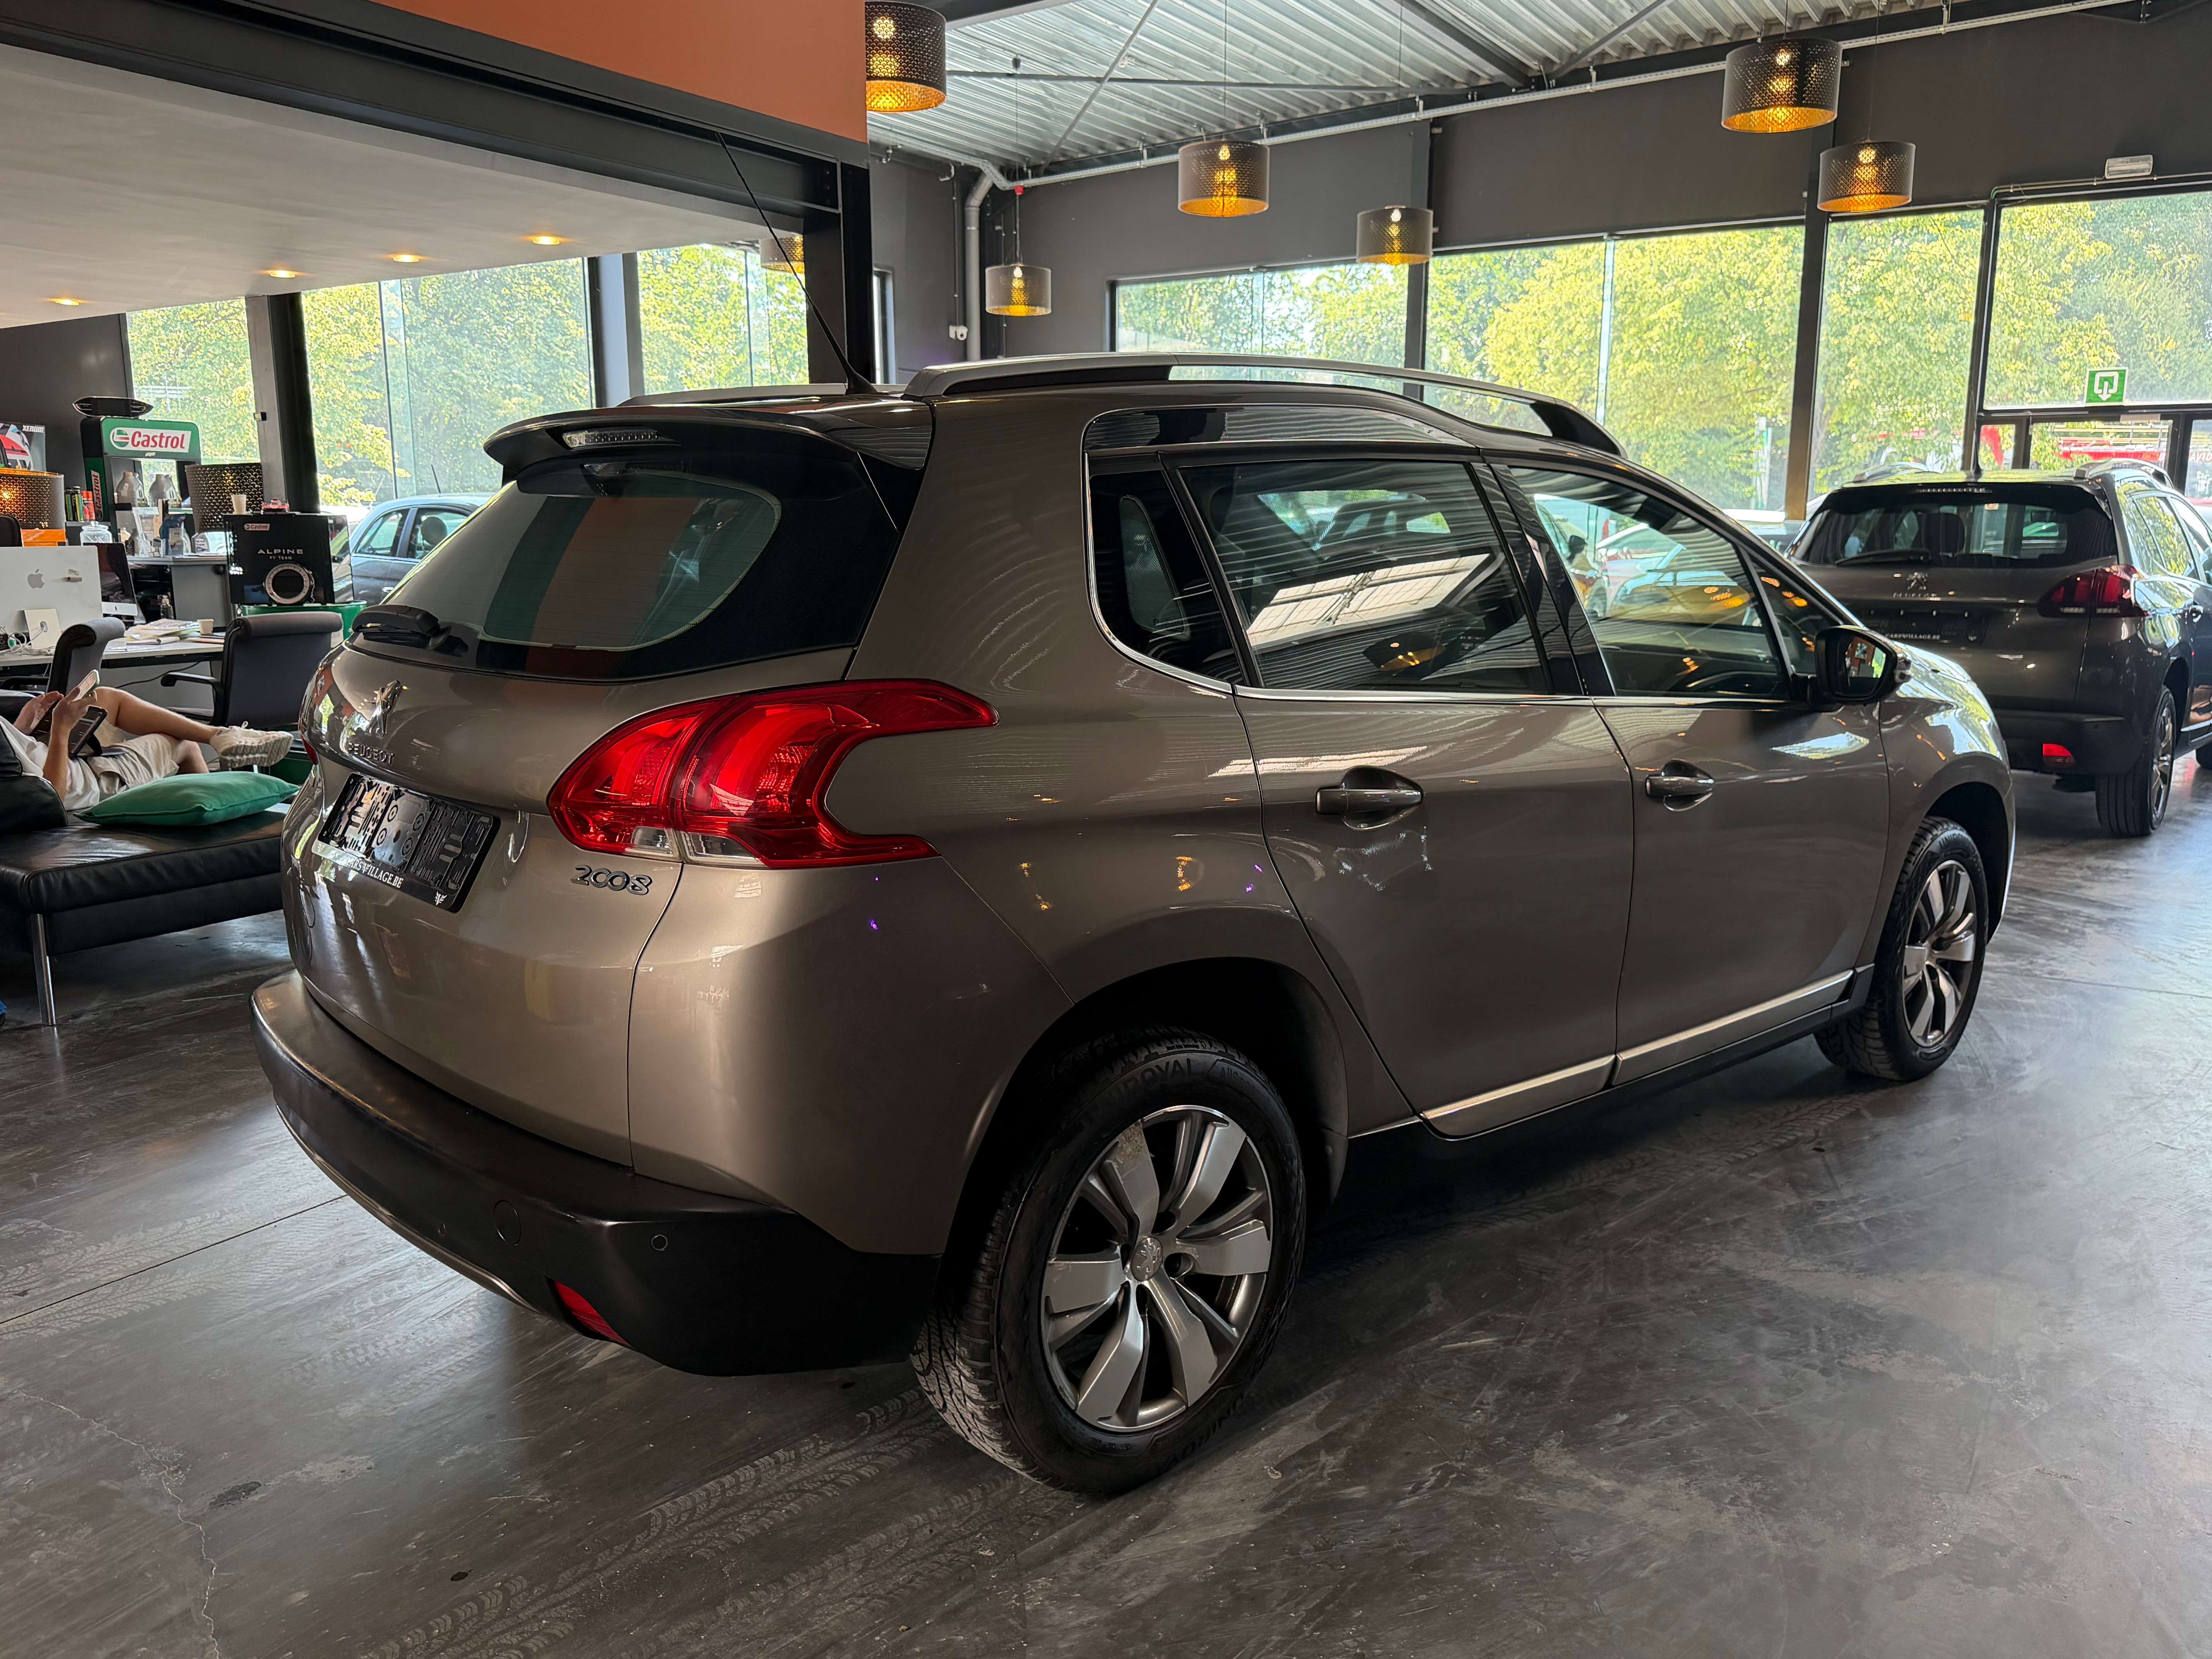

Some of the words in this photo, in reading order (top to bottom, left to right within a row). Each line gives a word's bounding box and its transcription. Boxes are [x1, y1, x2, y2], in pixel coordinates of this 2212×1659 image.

[131, 431, 185, 449] Castrol
[93, 474, 102, 509] Castrol
[348, 742, 394, 764] PEUGEOT
[570, 864, 653, 895] 2008
